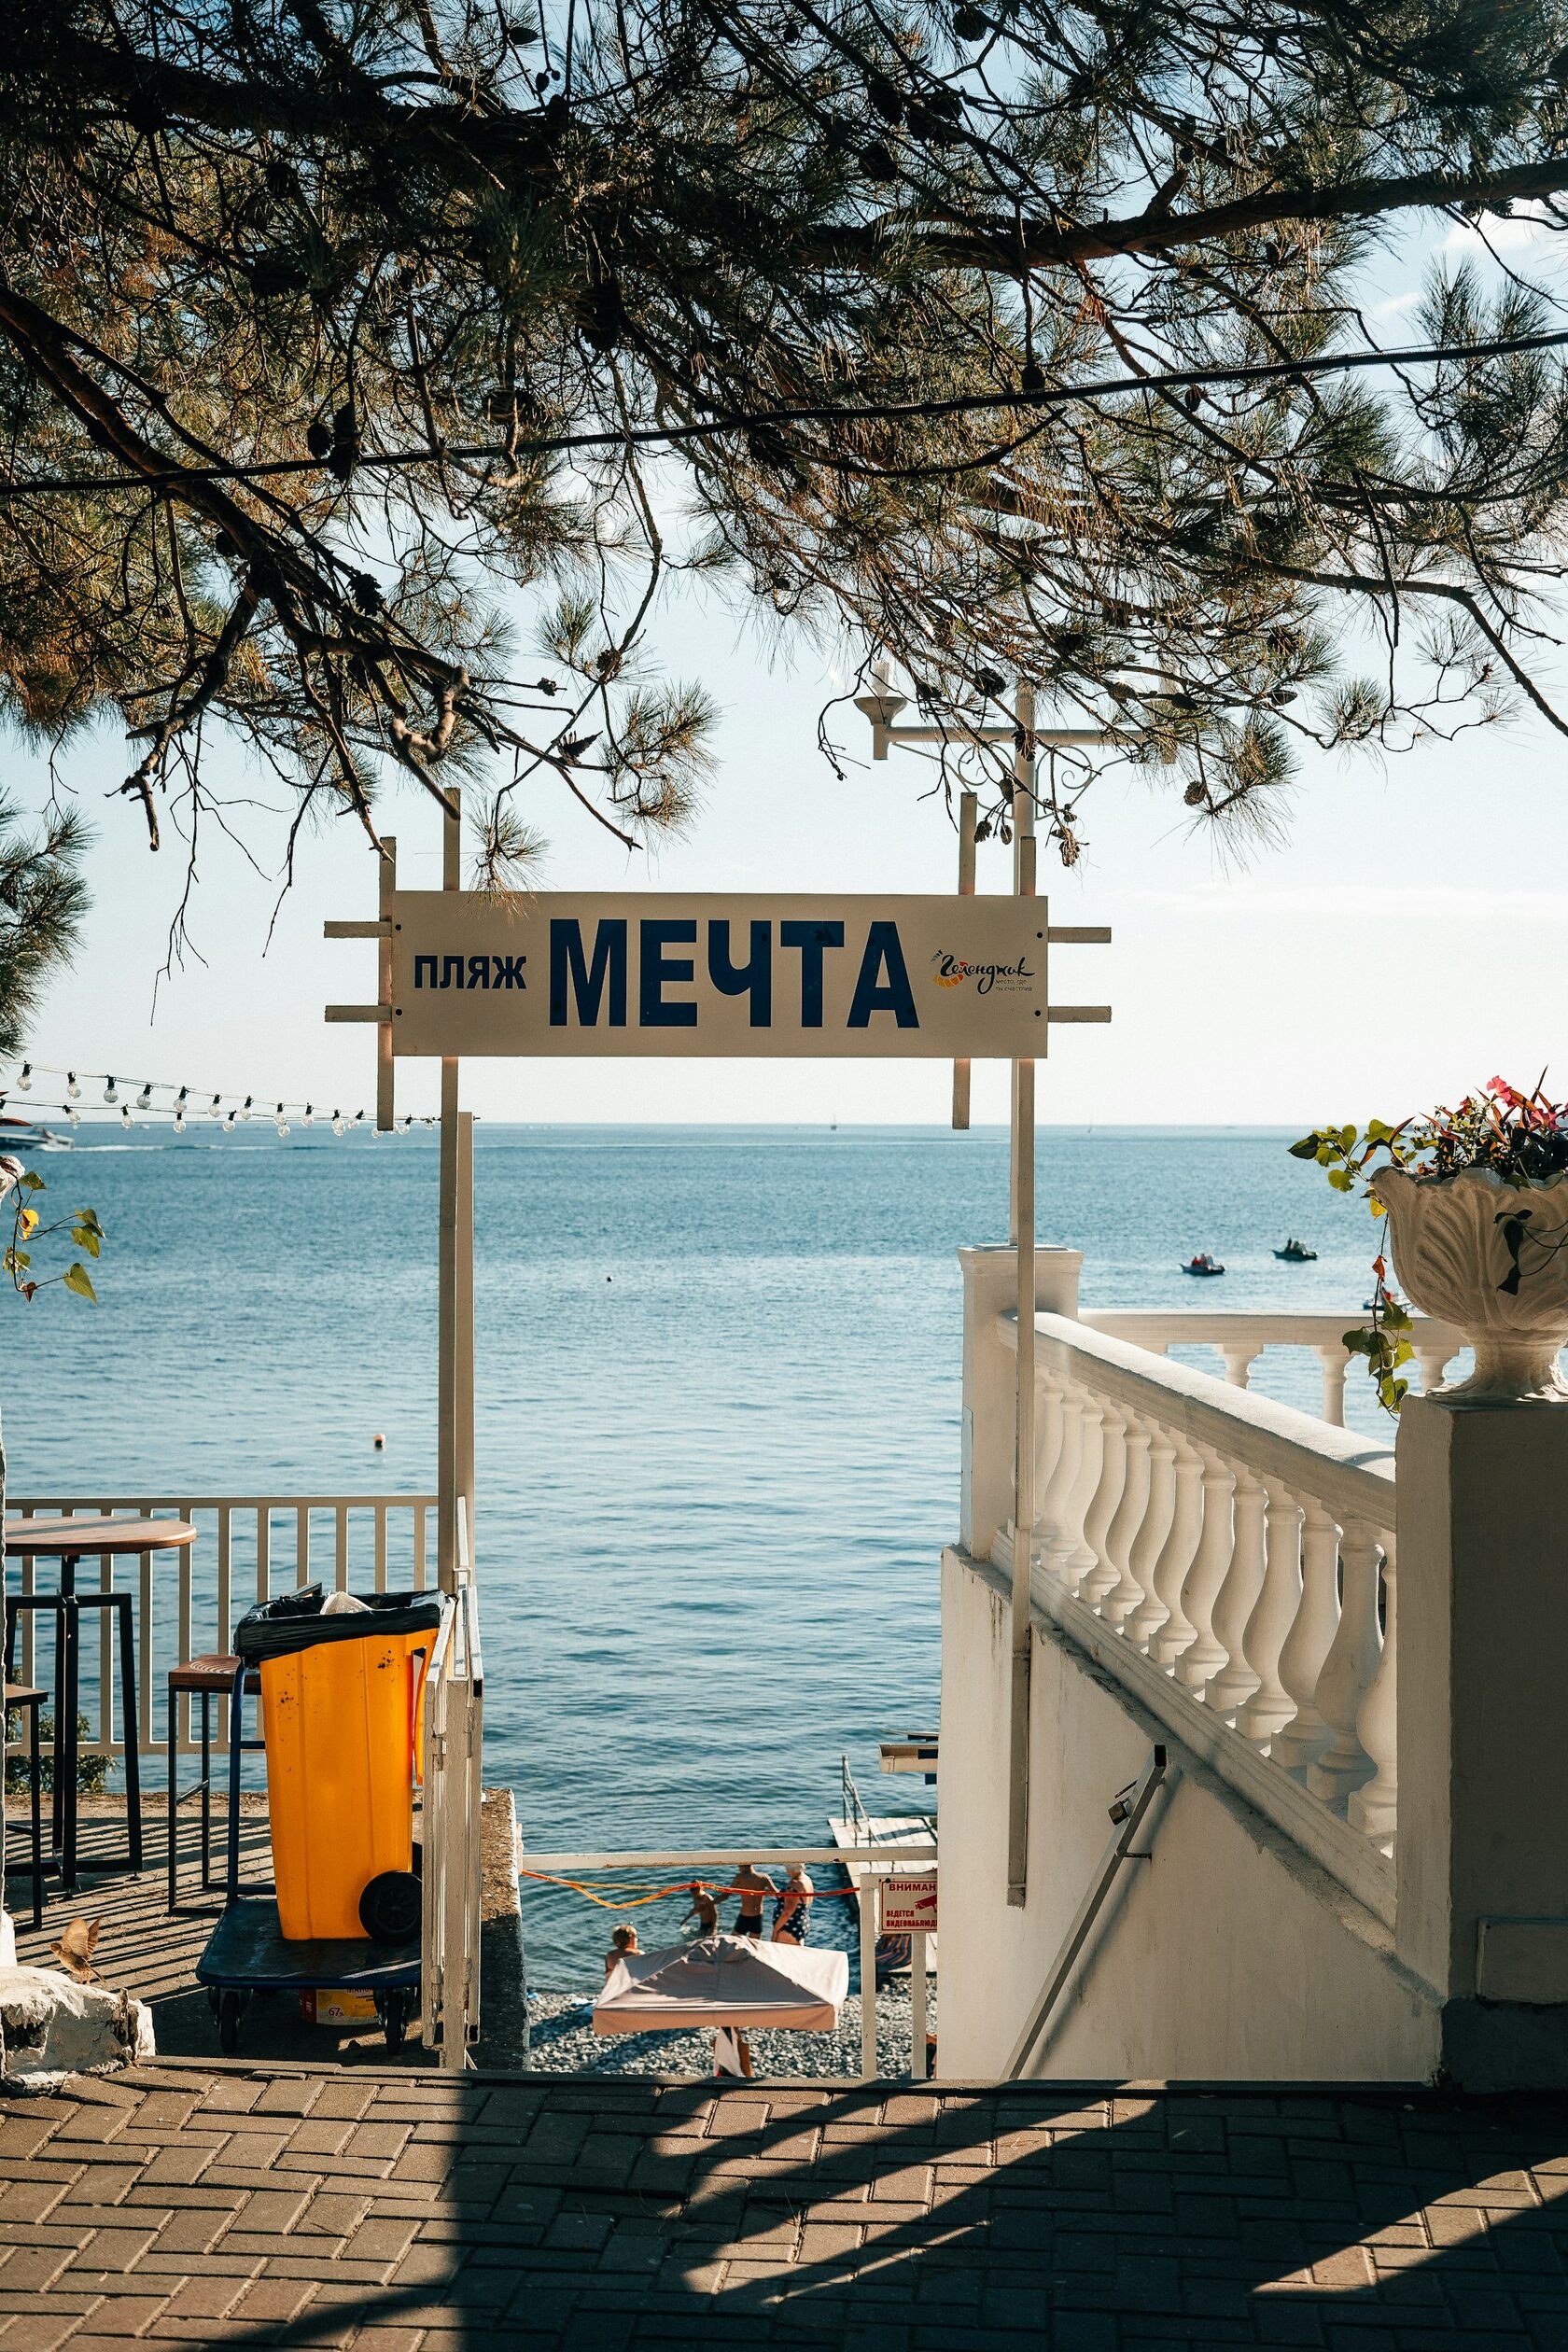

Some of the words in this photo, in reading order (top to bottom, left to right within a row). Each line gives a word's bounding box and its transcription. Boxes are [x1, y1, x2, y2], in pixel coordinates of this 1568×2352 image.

[413, 955, 526, 989] ПЛЯЖ
[549, 918, 920, 1029] МЕЧТА
[940, 954, 1036, 995] Геленджик
